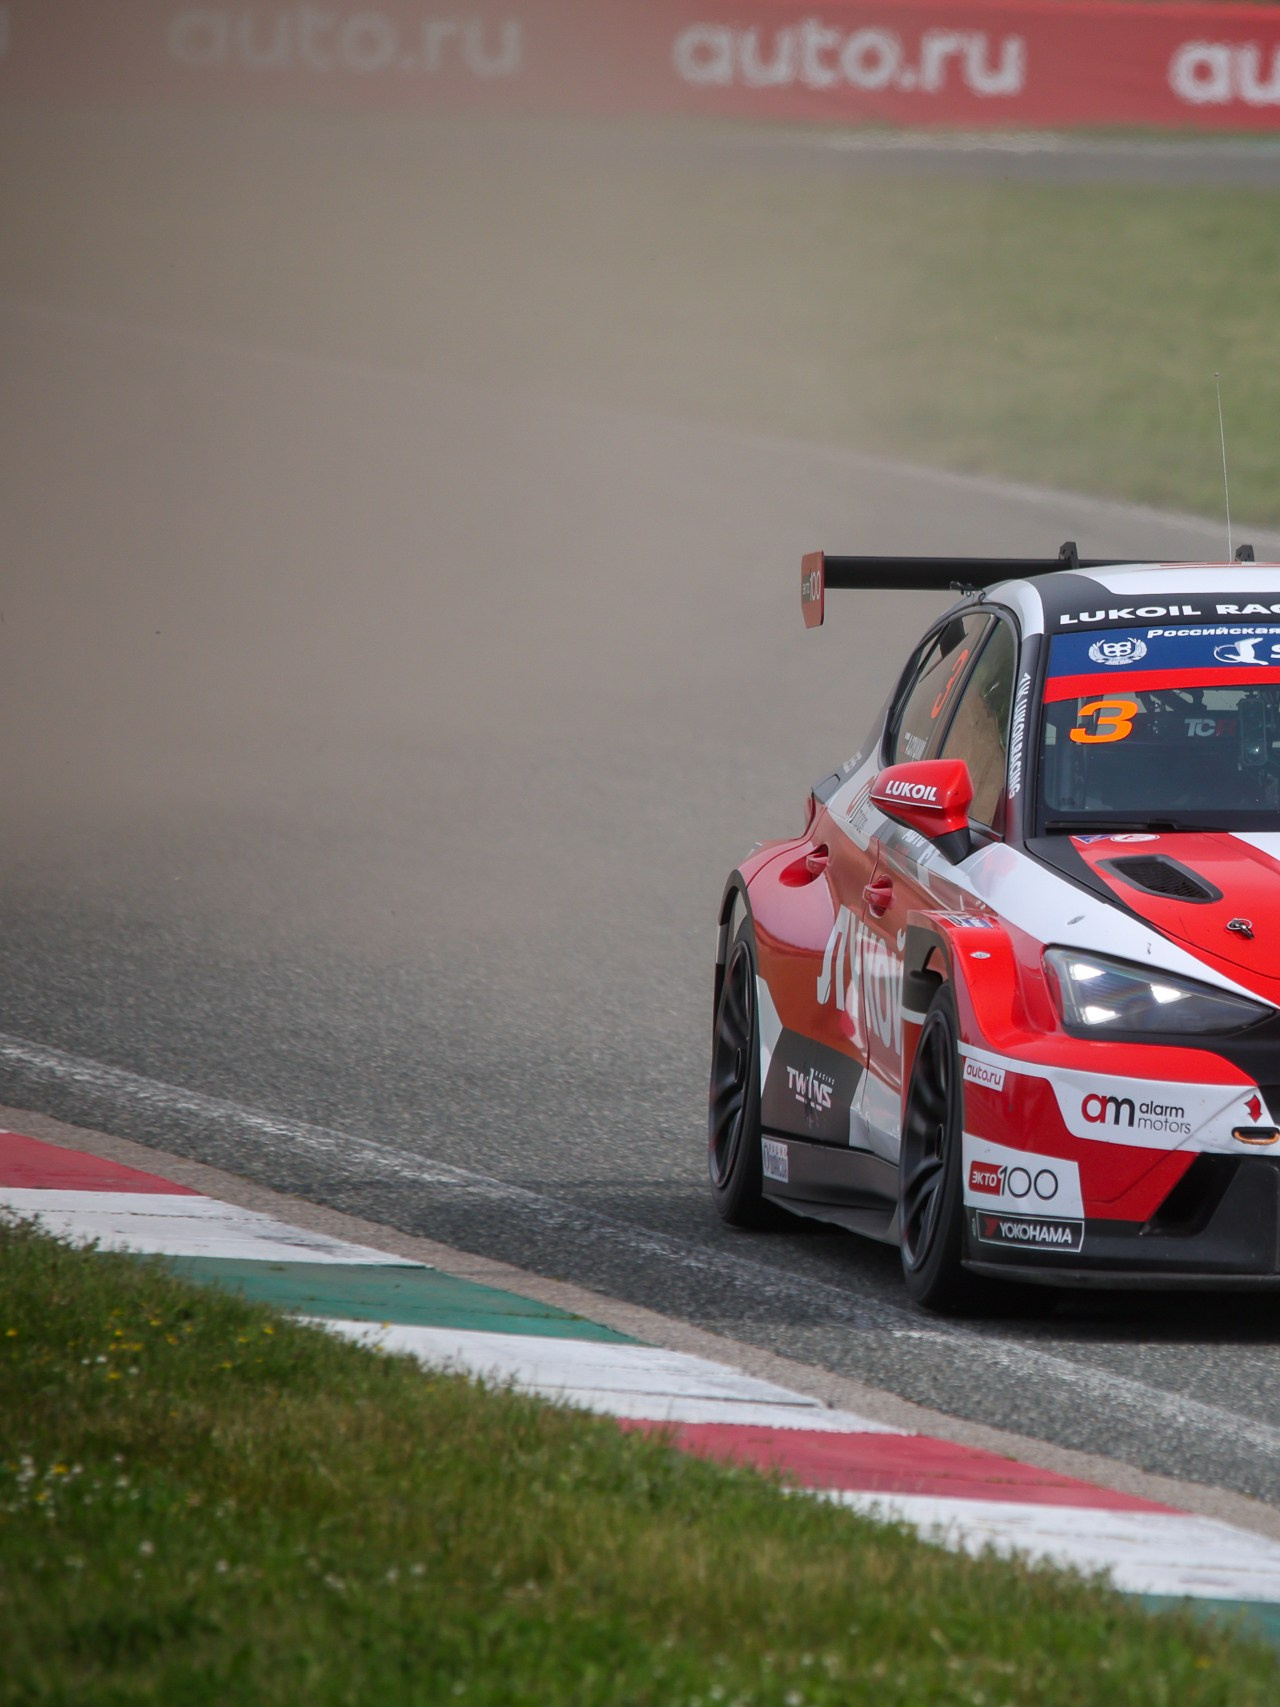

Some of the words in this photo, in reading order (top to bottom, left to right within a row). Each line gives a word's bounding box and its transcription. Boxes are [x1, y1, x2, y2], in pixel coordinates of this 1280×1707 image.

[170, 2, 523, 79] auto.ru
[672, 20, 1026, 96] auto.ru
[1059, 605, 1201, 626] LUKOIL
[1147, 626, 1280, 639] Российская
[1069, 700, 1139, 744] 3
[885, 780, 938, 802] LUKOIL
[966, 1062, 1001, 1086] auto.ru
[1139, 1101, 1185, 1119] alarm
[1137, 1116, 1191, 1135] motors
[971, 1168, 997, 1187] ЭКТО
[999, 1221, 1073, 1244] YOKOHAMA
